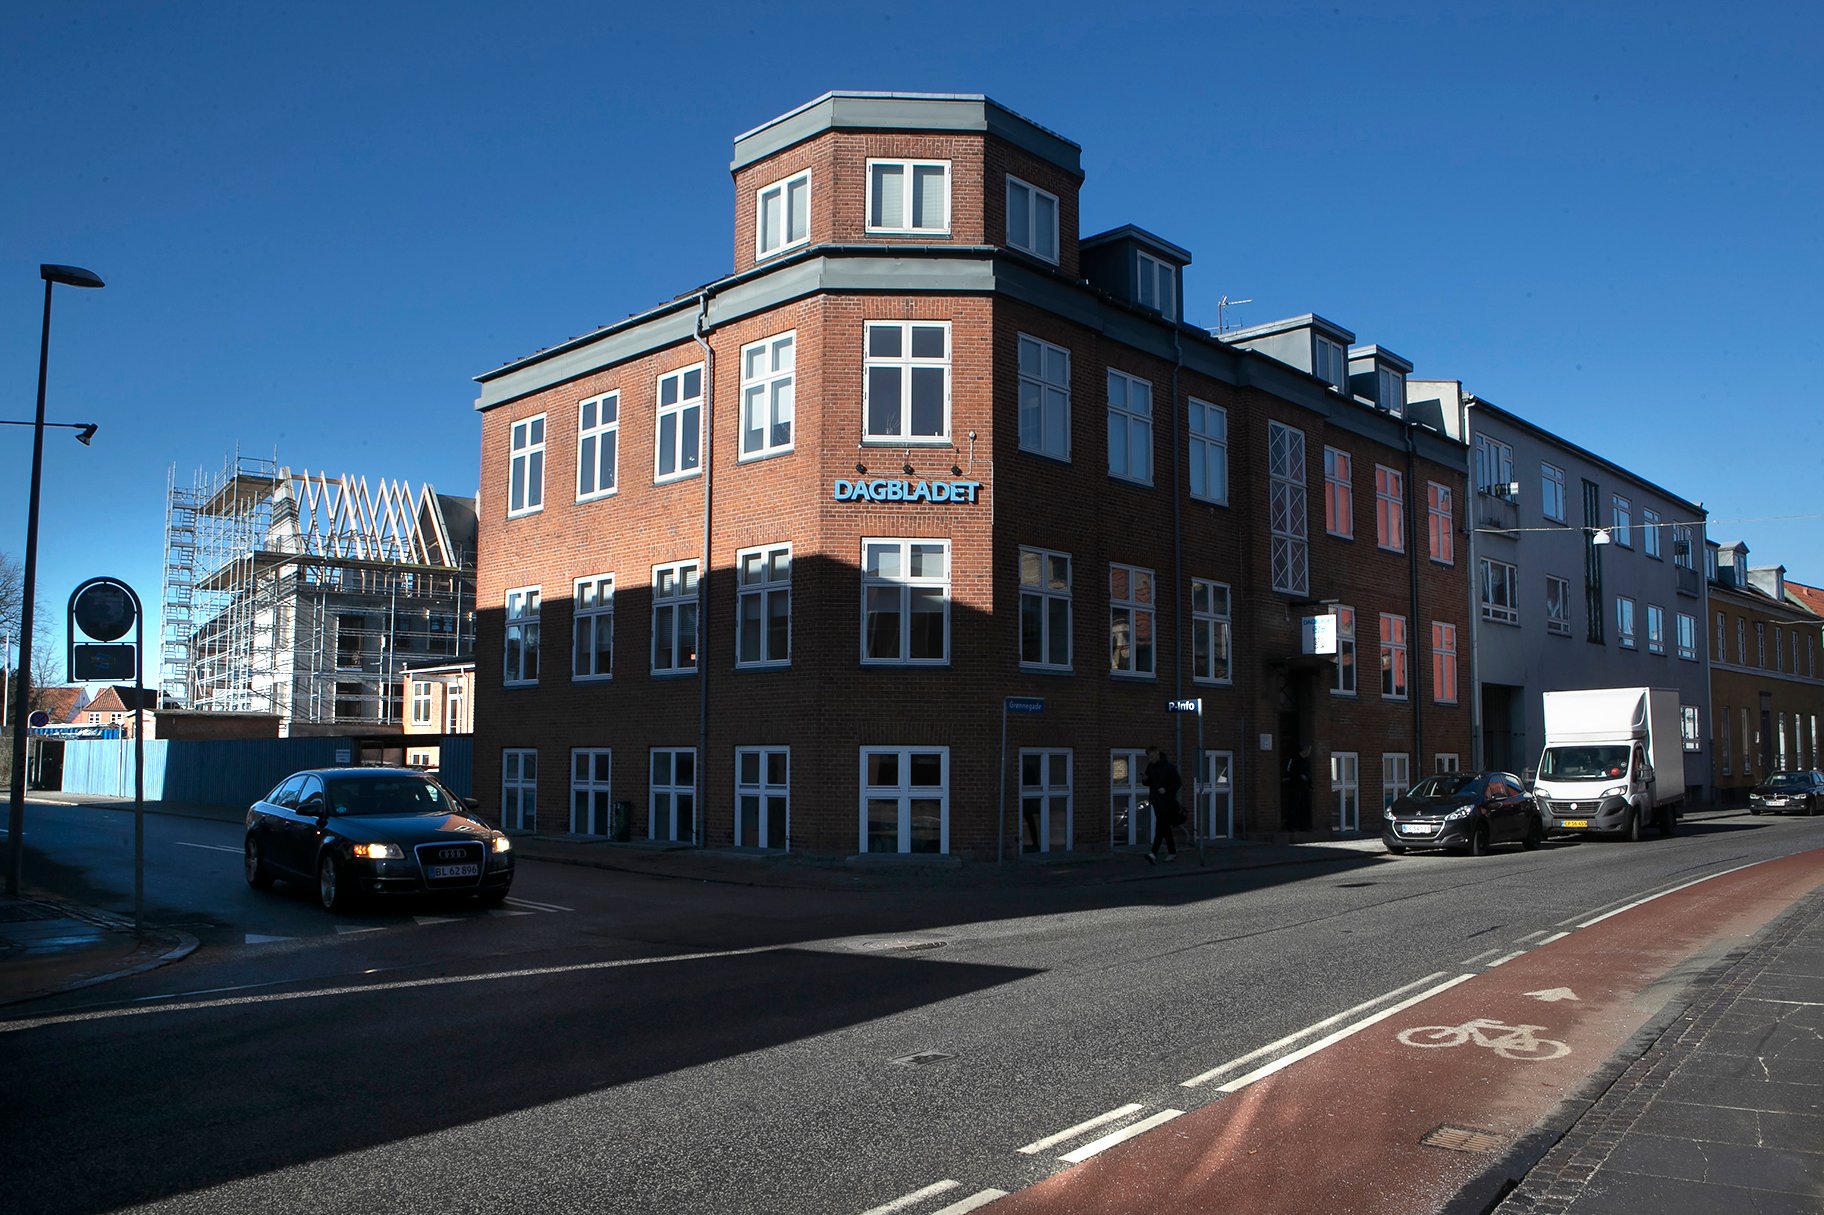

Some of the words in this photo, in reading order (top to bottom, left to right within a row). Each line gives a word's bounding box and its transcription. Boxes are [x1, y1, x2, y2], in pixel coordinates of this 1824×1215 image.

[834, 480, 980, 502] DAGBLADET
[1168, 700, 1195, 711] P-Info
[435, 867, 447, 877] BL
[449, 865, 460, 876] 62
[461, 864, 477, 876] 896
